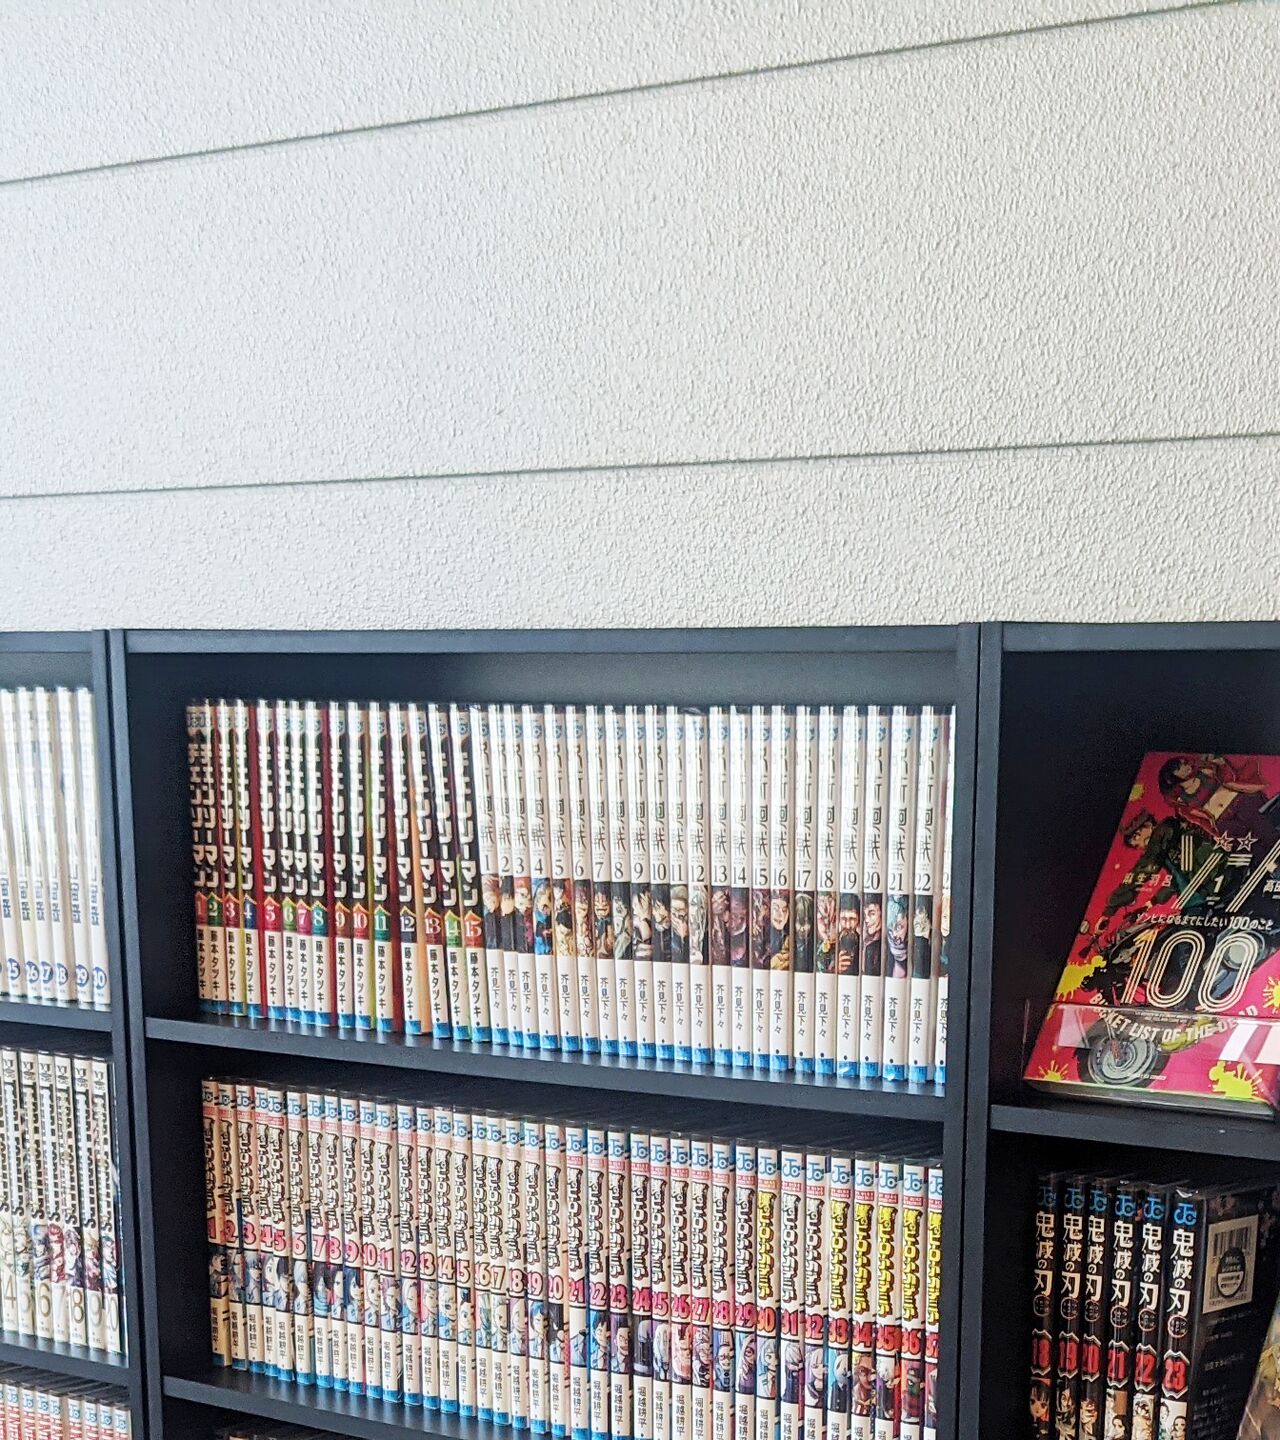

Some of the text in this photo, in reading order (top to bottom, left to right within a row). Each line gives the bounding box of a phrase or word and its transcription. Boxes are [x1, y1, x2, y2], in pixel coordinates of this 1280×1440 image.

[555, 858, 564, 876] 5
[634, 862, 644, 880] 9
[772, 868, 788, 886] 16
[796, 870, 812, 888] 17
[265, 906, 276, 922] 5
[353, 912, 368, 929] 10
[425, 918, 441, 935] 13
[465, 920, 482, 937] 15
[1136, 913, 1274, 931] ゾンビになるまでにしたい100のこと
[355, 943, 365, 1013] 藤本タツキ
[429, 948, 442, 1017] 藤本タツキ
[1121, 928, 1258, 1013] 100
[561, 973, 570, 1016] 芥見下々
[842, 994, 852, 1040] 芥見下々
[1111, 1220, 1133, 1308] 鬼滅の刃
[1167, 1228, 1195, 1317] 鬼滅の刃
[1108, 1350, 1125, 1380] 21
[1136, 1352, 1156, 1384] 22
[1165, 1358, 1186, 1392] 23
